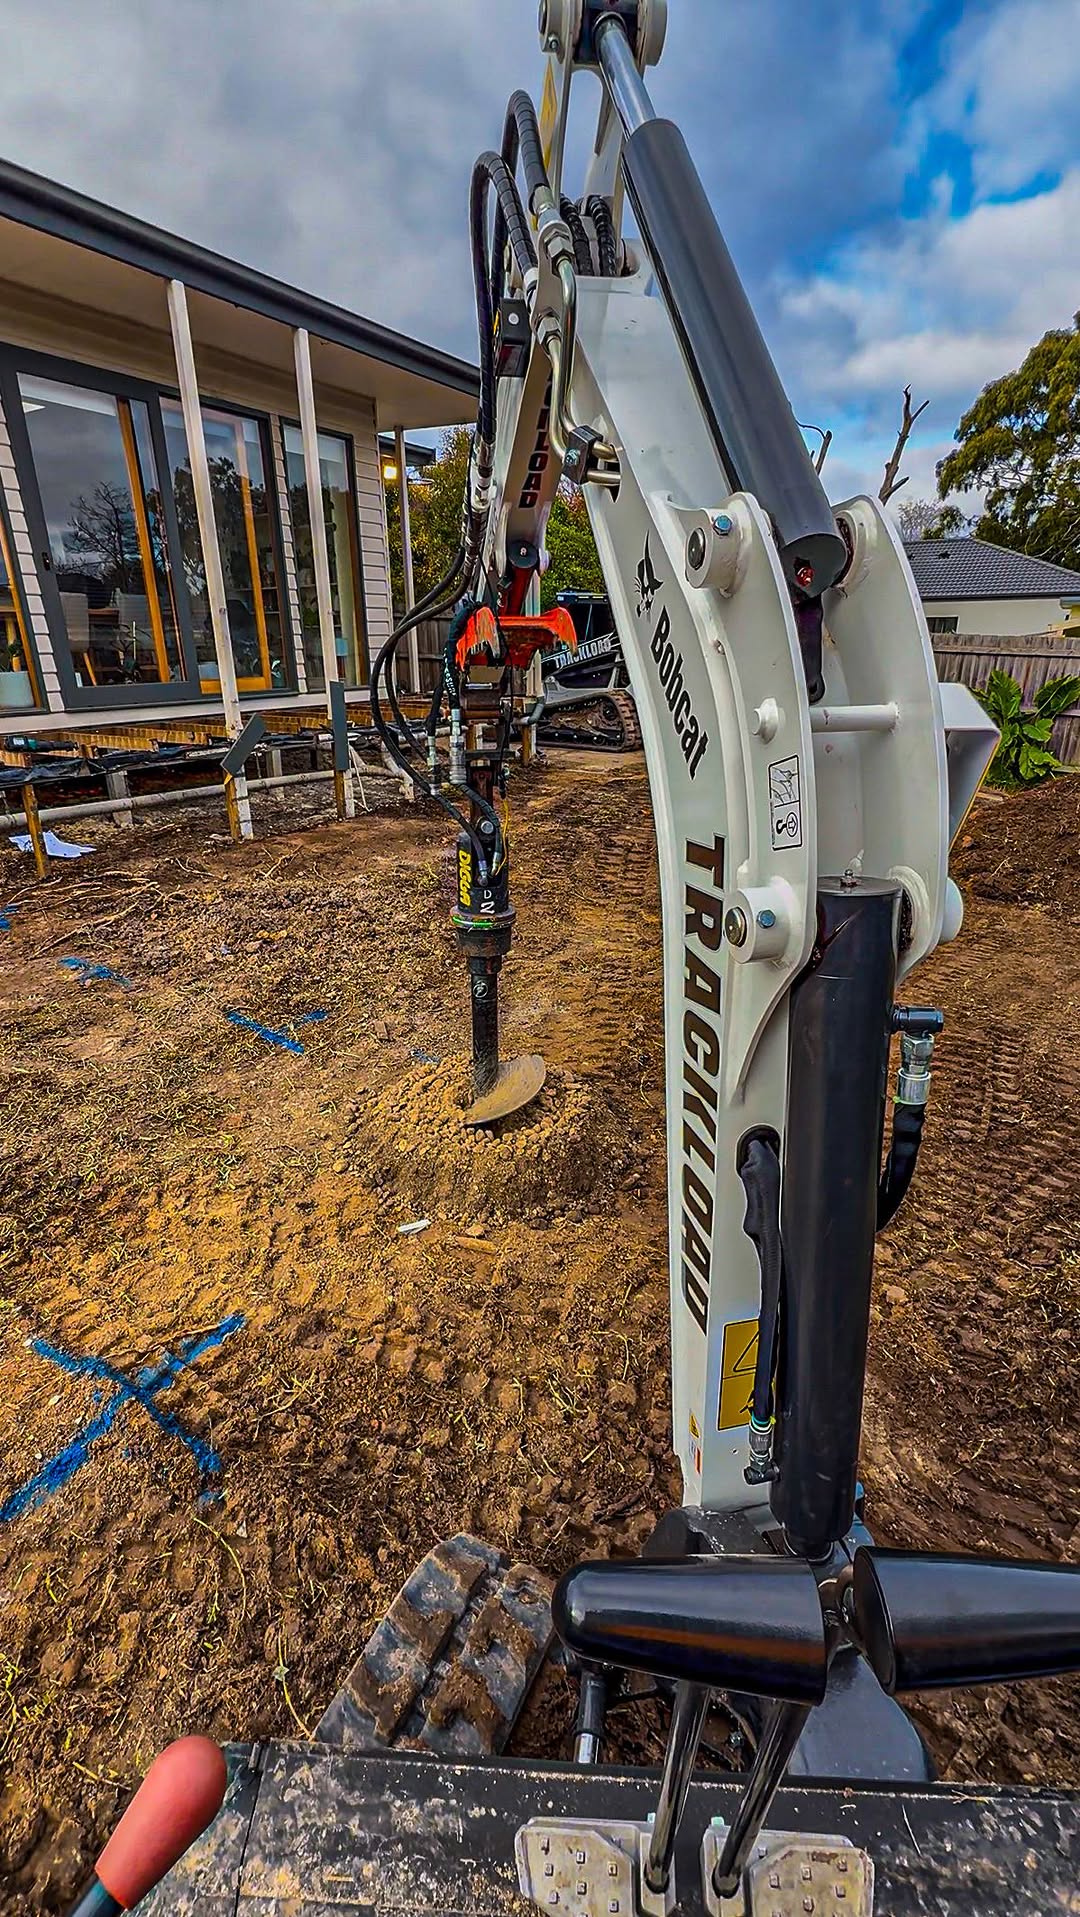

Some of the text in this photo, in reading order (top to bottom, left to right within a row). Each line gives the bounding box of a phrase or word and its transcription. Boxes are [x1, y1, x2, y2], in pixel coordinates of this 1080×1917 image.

[650, 605, 709, 781] Bobcat
[483, 889, 492, 899] D
[682, 833, 726, 1337] TRACKLOAD
